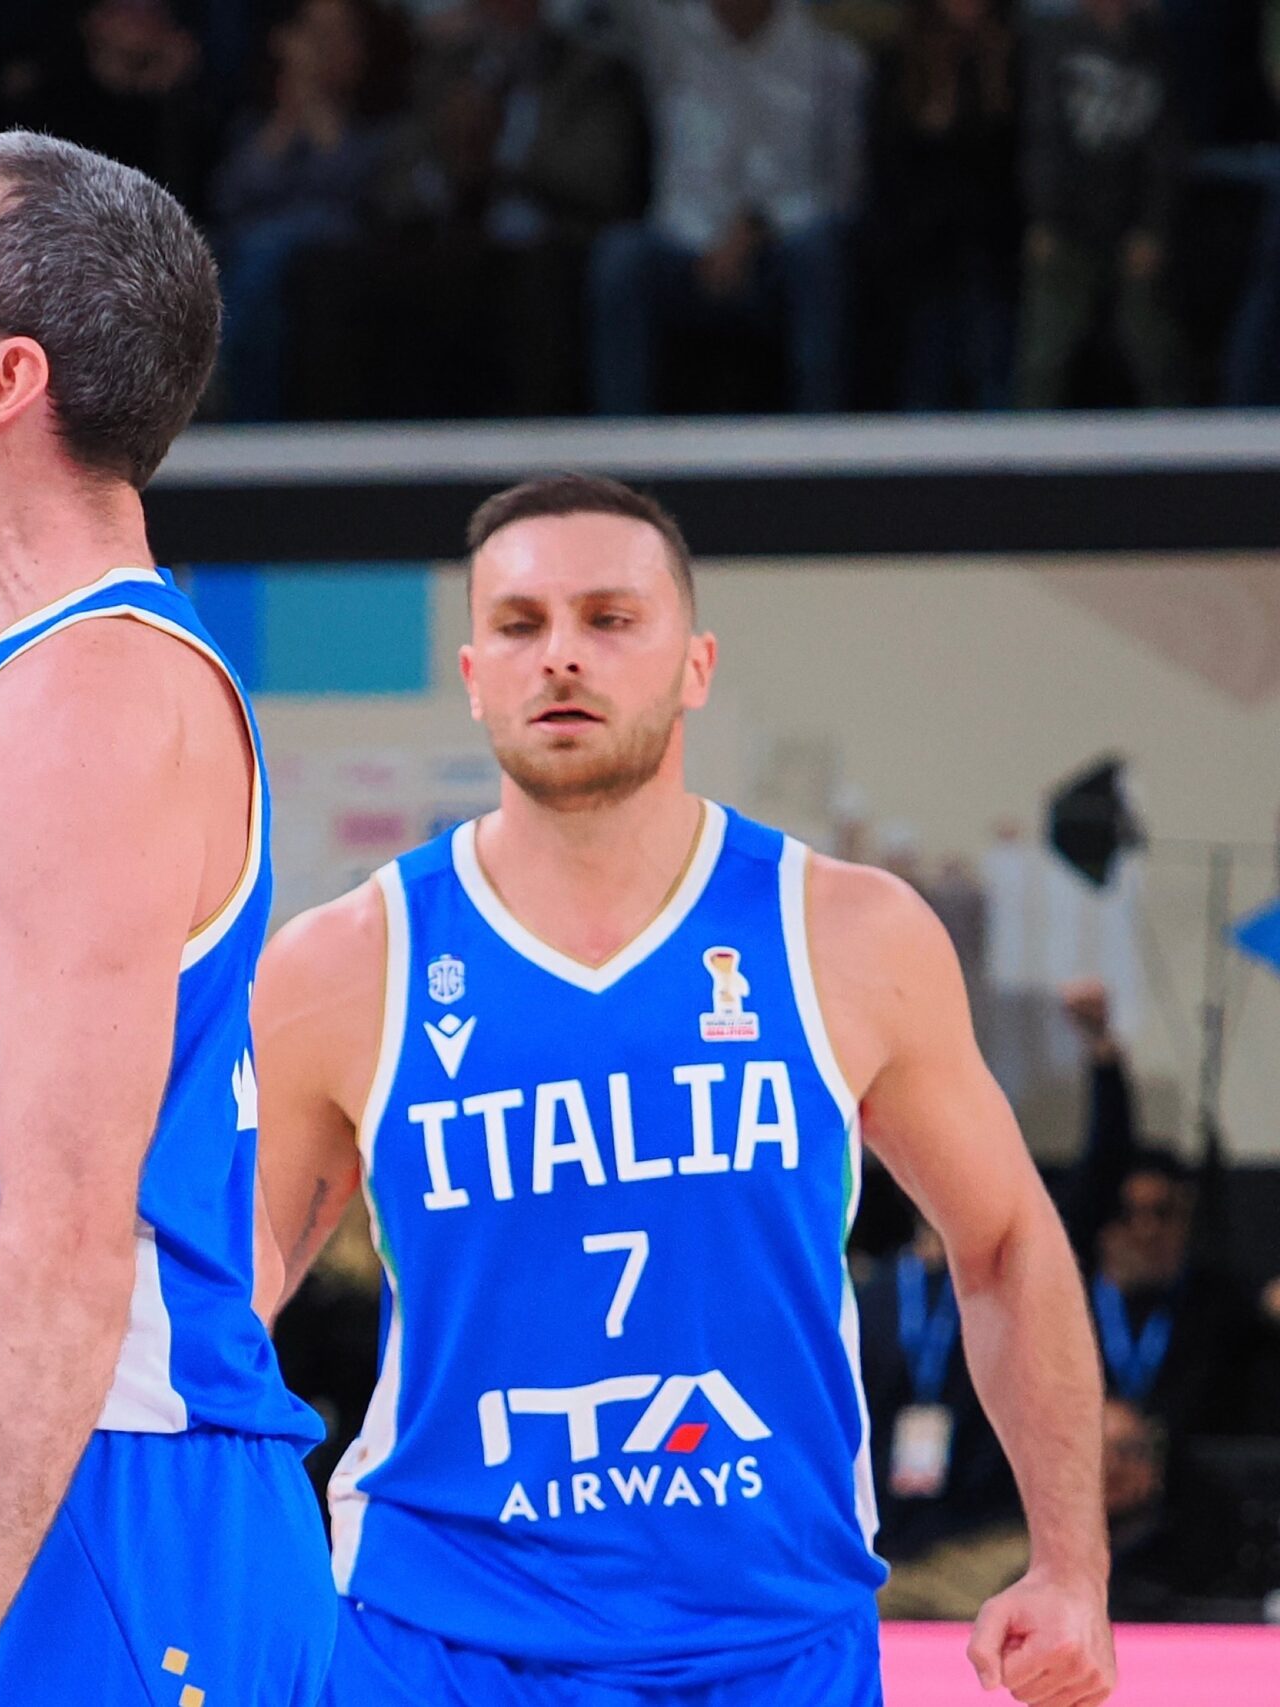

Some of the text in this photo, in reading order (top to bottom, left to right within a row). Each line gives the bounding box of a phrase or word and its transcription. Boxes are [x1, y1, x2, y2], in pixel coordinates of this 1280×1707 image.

[408, 1060, 800, 1211] ITALIA
[581, 1230, 650, 1339] 7
[477, 1369, 773, 1468] ITA
[499, 1455, 764, 1524] AIRWAYS
